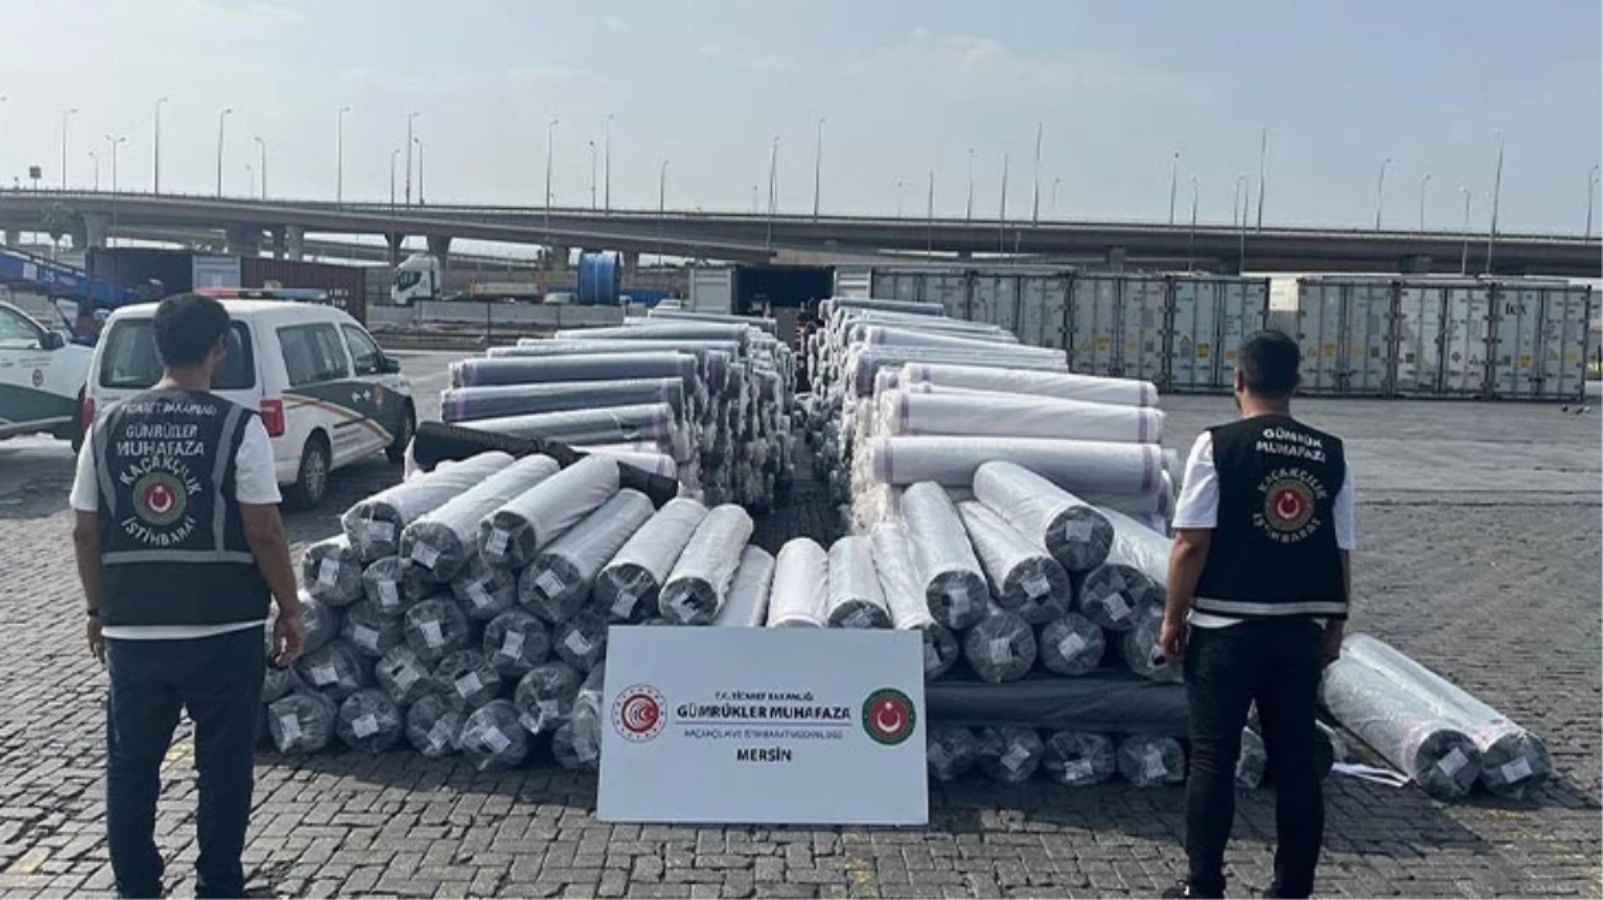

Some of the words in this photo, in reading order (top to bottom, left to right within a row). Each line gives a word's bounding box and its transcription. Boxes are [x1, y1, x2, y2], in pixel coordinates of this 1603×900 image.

[116, 441, 204, 456] MUHAFAZA
[676, 702, 767, 718] GÜMRÜKLER
[769, 705, 851, 719] MUHAFAZA
[736, 746, 792, 763] MERSİN
